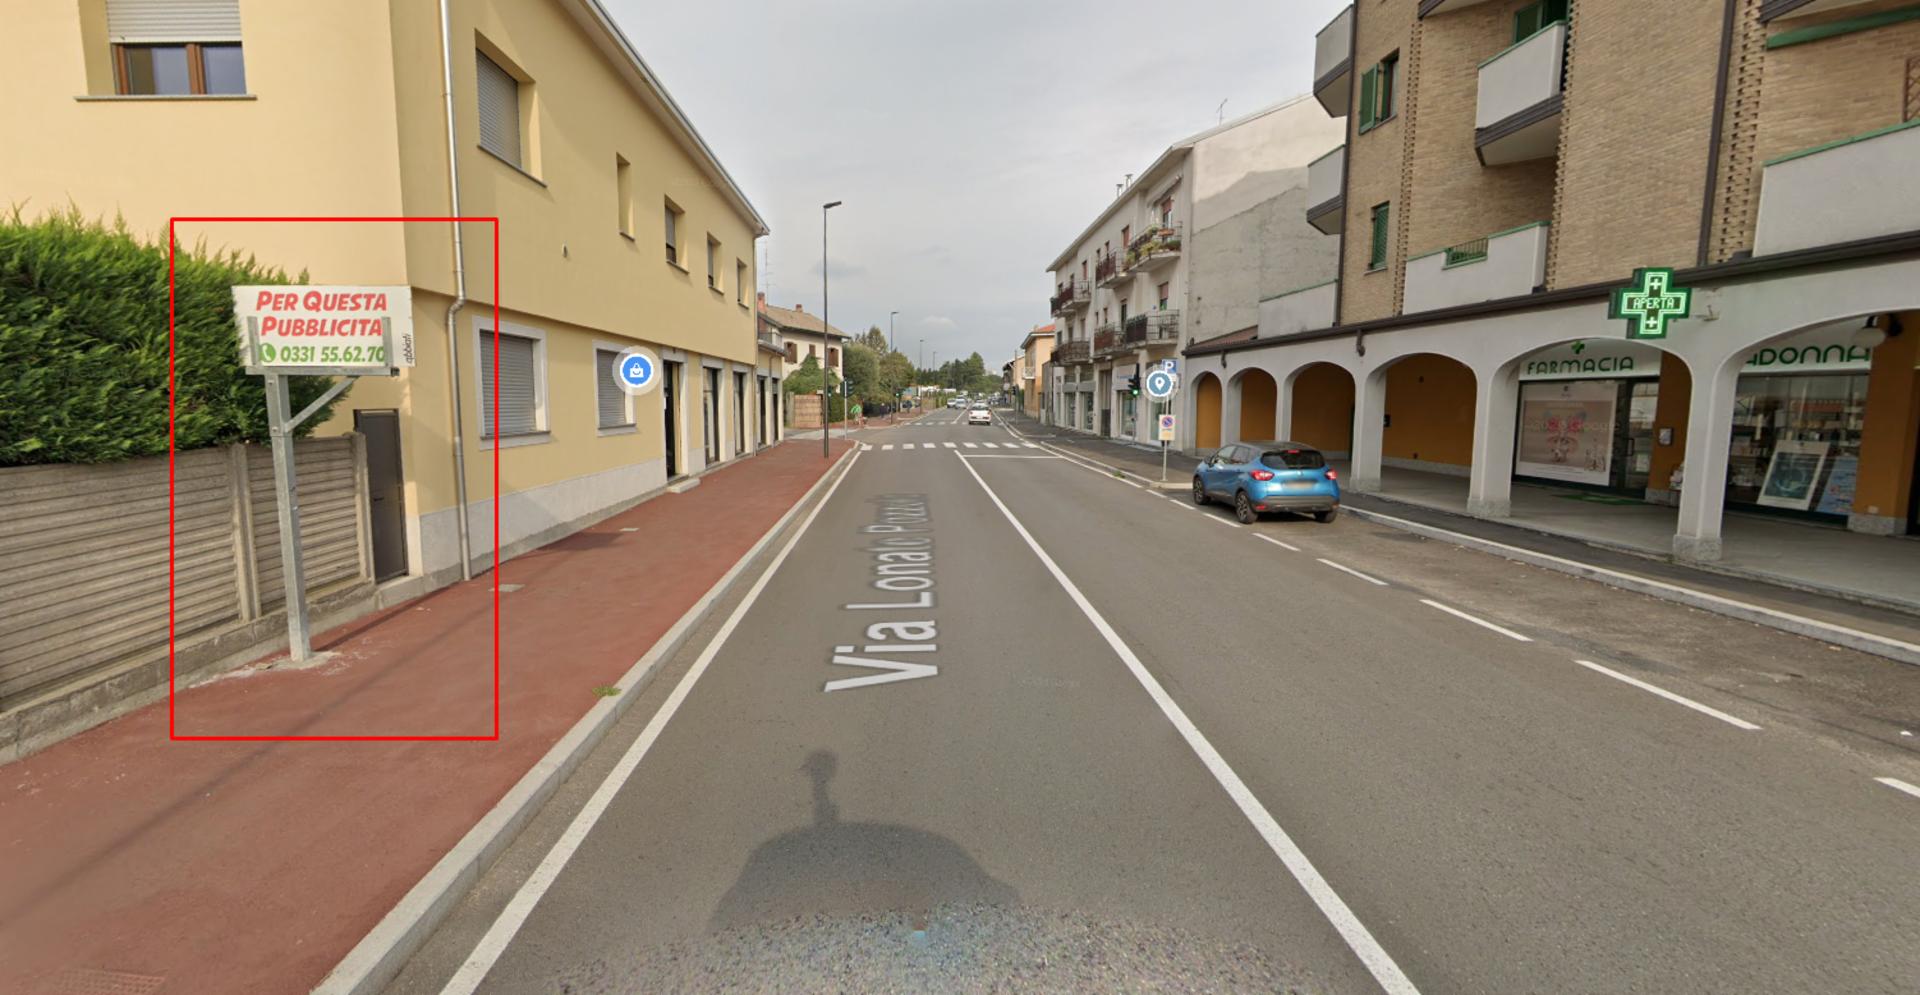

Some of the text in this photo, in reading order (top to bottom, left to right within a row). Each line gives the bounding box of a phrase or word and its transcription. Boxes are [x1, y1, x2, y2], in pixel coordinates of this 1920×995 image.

[255, 290, 387, 312] PER QUESTA
[1633, 297, 1675, 309] APERTA
[261, 316, 382, 337] PUBBLICITA
[280, 345, 386, 363] 0331 55.62.70
[1527, 356, 1634, 375] FARMACIA
